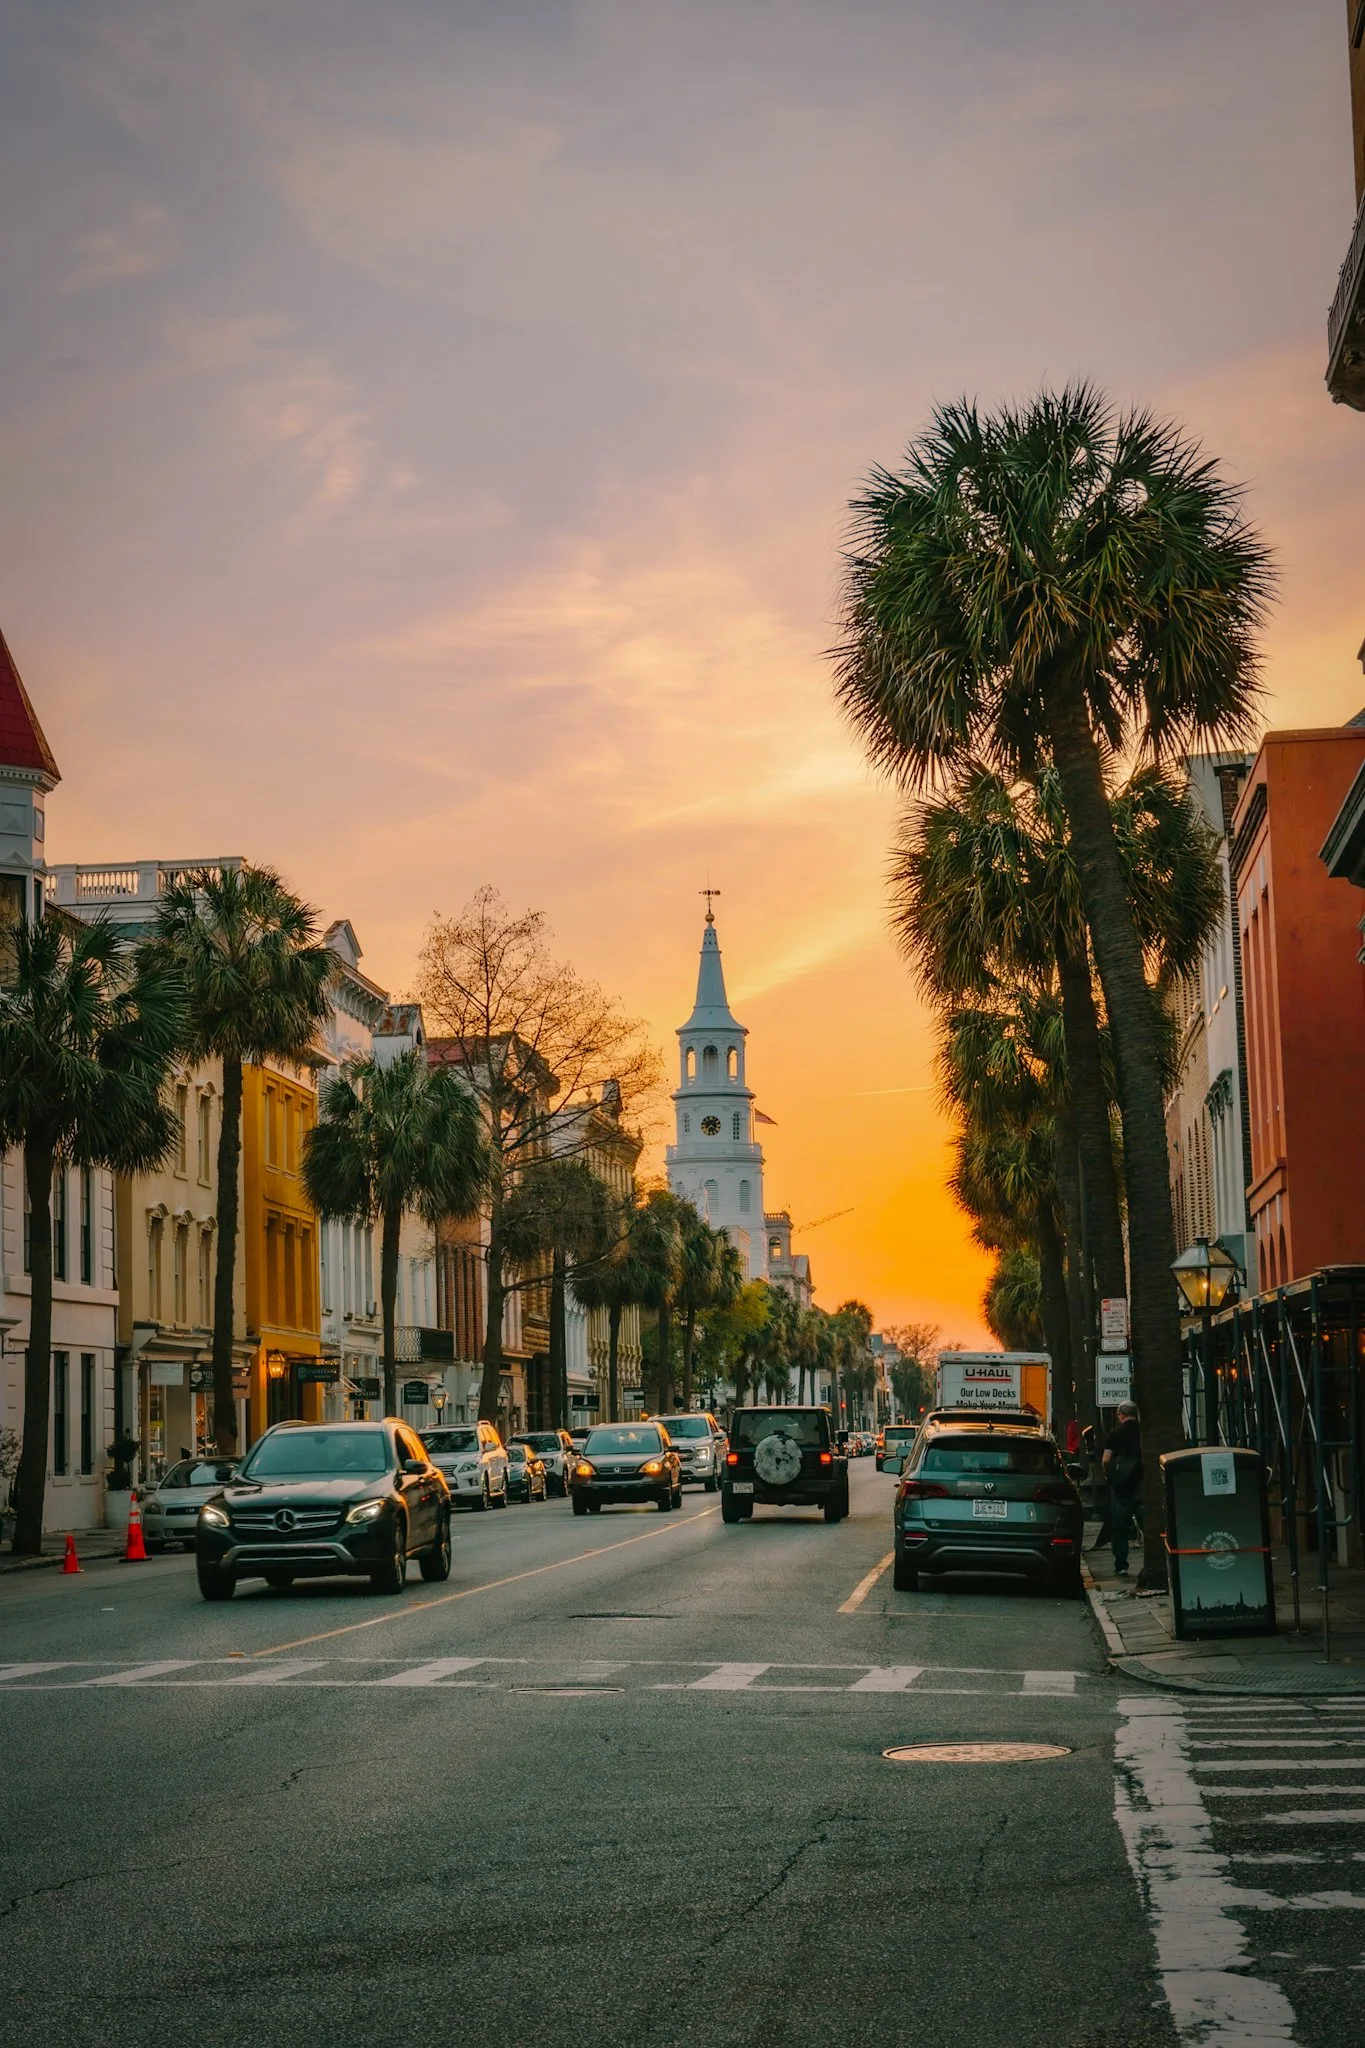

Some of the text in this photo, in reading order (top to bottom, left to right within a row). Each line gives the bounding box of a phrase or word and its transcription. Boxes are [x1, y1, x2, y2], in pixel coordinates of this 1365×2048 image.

[1105, 1363, 1124, 1371] NOISE
[965, 1368, 1012, 1378] U-HAUL
[1101, 1376, 1129, 1385] ORDINANCE
[960, 1387, 1017, 1398] Our Low Decks
[1102, 1389, 1128, 1398] ENFORCED
[1212, 1531, 1240, 1550] CHARLESTON
